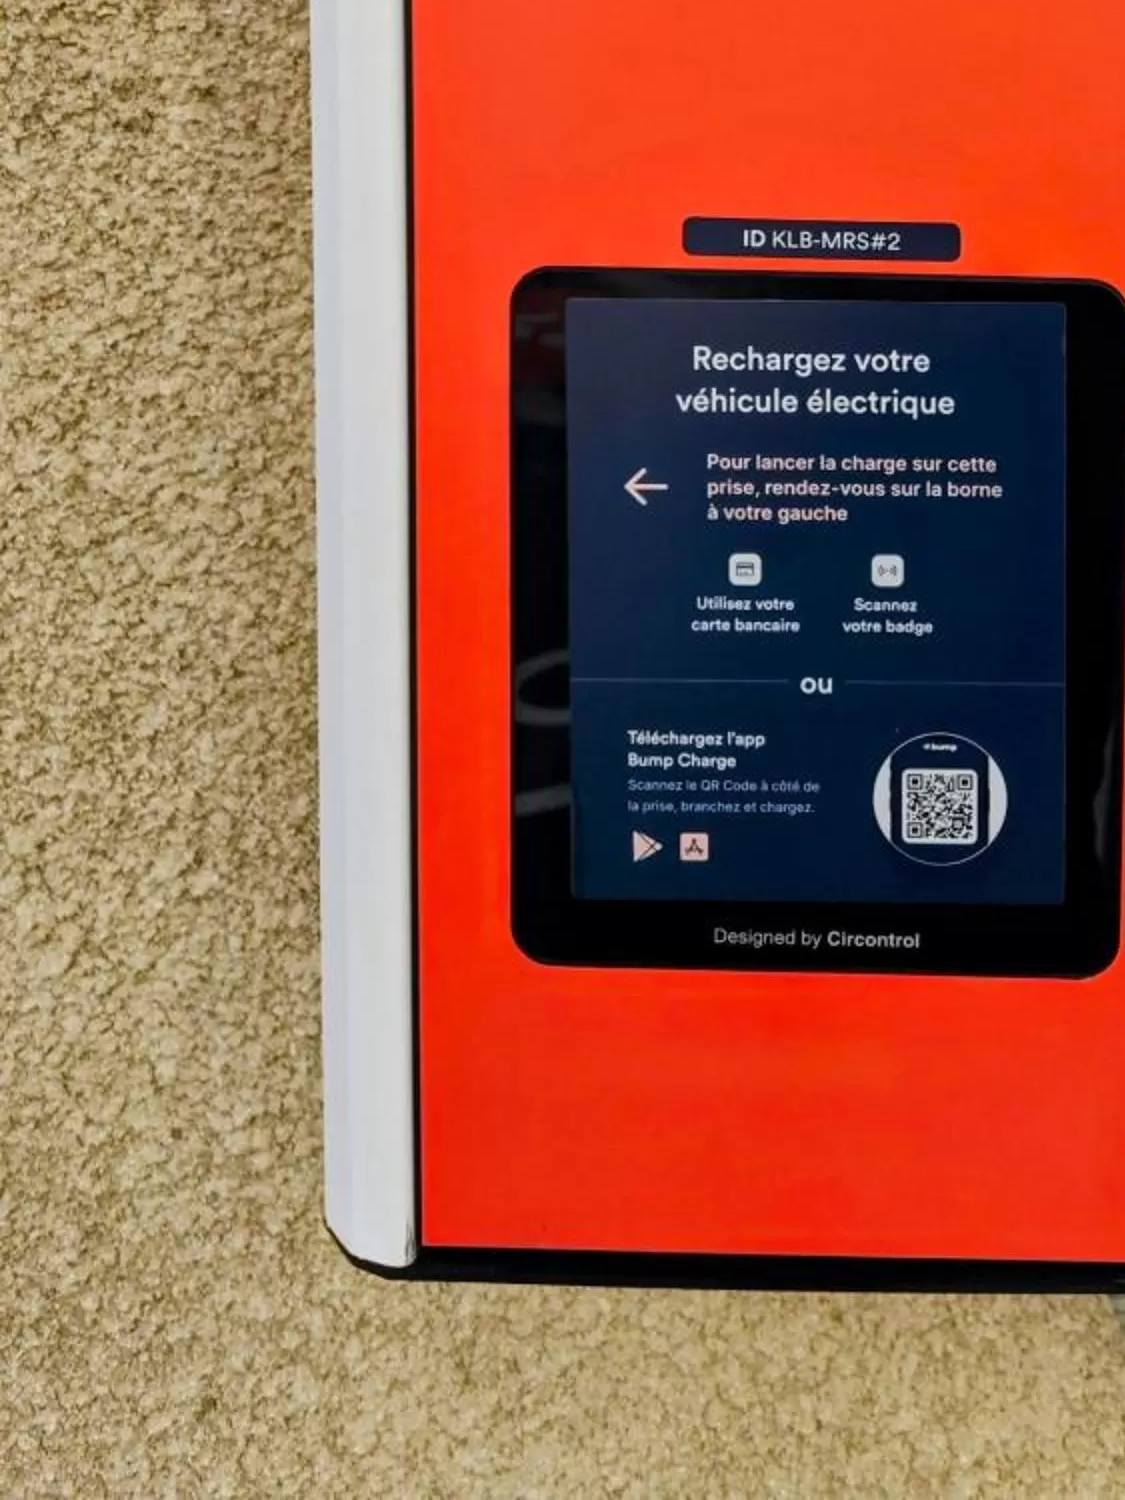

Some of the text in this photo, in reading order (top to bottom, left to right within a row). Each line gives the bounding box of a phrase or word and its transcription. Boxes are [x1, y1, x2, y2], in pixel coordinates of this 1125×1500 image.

[744, 230, 900, 250] ID KLB-MRS#2
[694, 346, 930, 377] Rechargez votre
[676, 388, 954, 420] véhicule électrique
[707, 454, 996, 475] Pour lancer la charge sur cette
[707, 479, 1002, 498] prise, rendez-vous sur la borne
[708, 503, 848, 524] à votre gauche
[697, 596, 794, 610] Utilisez votre
[854, 598, 917, 612] Scannez
[692, 618, 800, 632] carte bancaire
[843, 620, 933, 636] votre badge
[800, 677, 832, 694] ou
[628, 730, 765, 748] Téléchargez l'app
[628, 752, 736, 770] Bump Charge
[628, 779, 820, 792] Scannez le QR Code à côté de
[628, 800, 814, 816] la prise, branchez et chargez.
[714, 928, 919, 949] Designed by Circontrol
